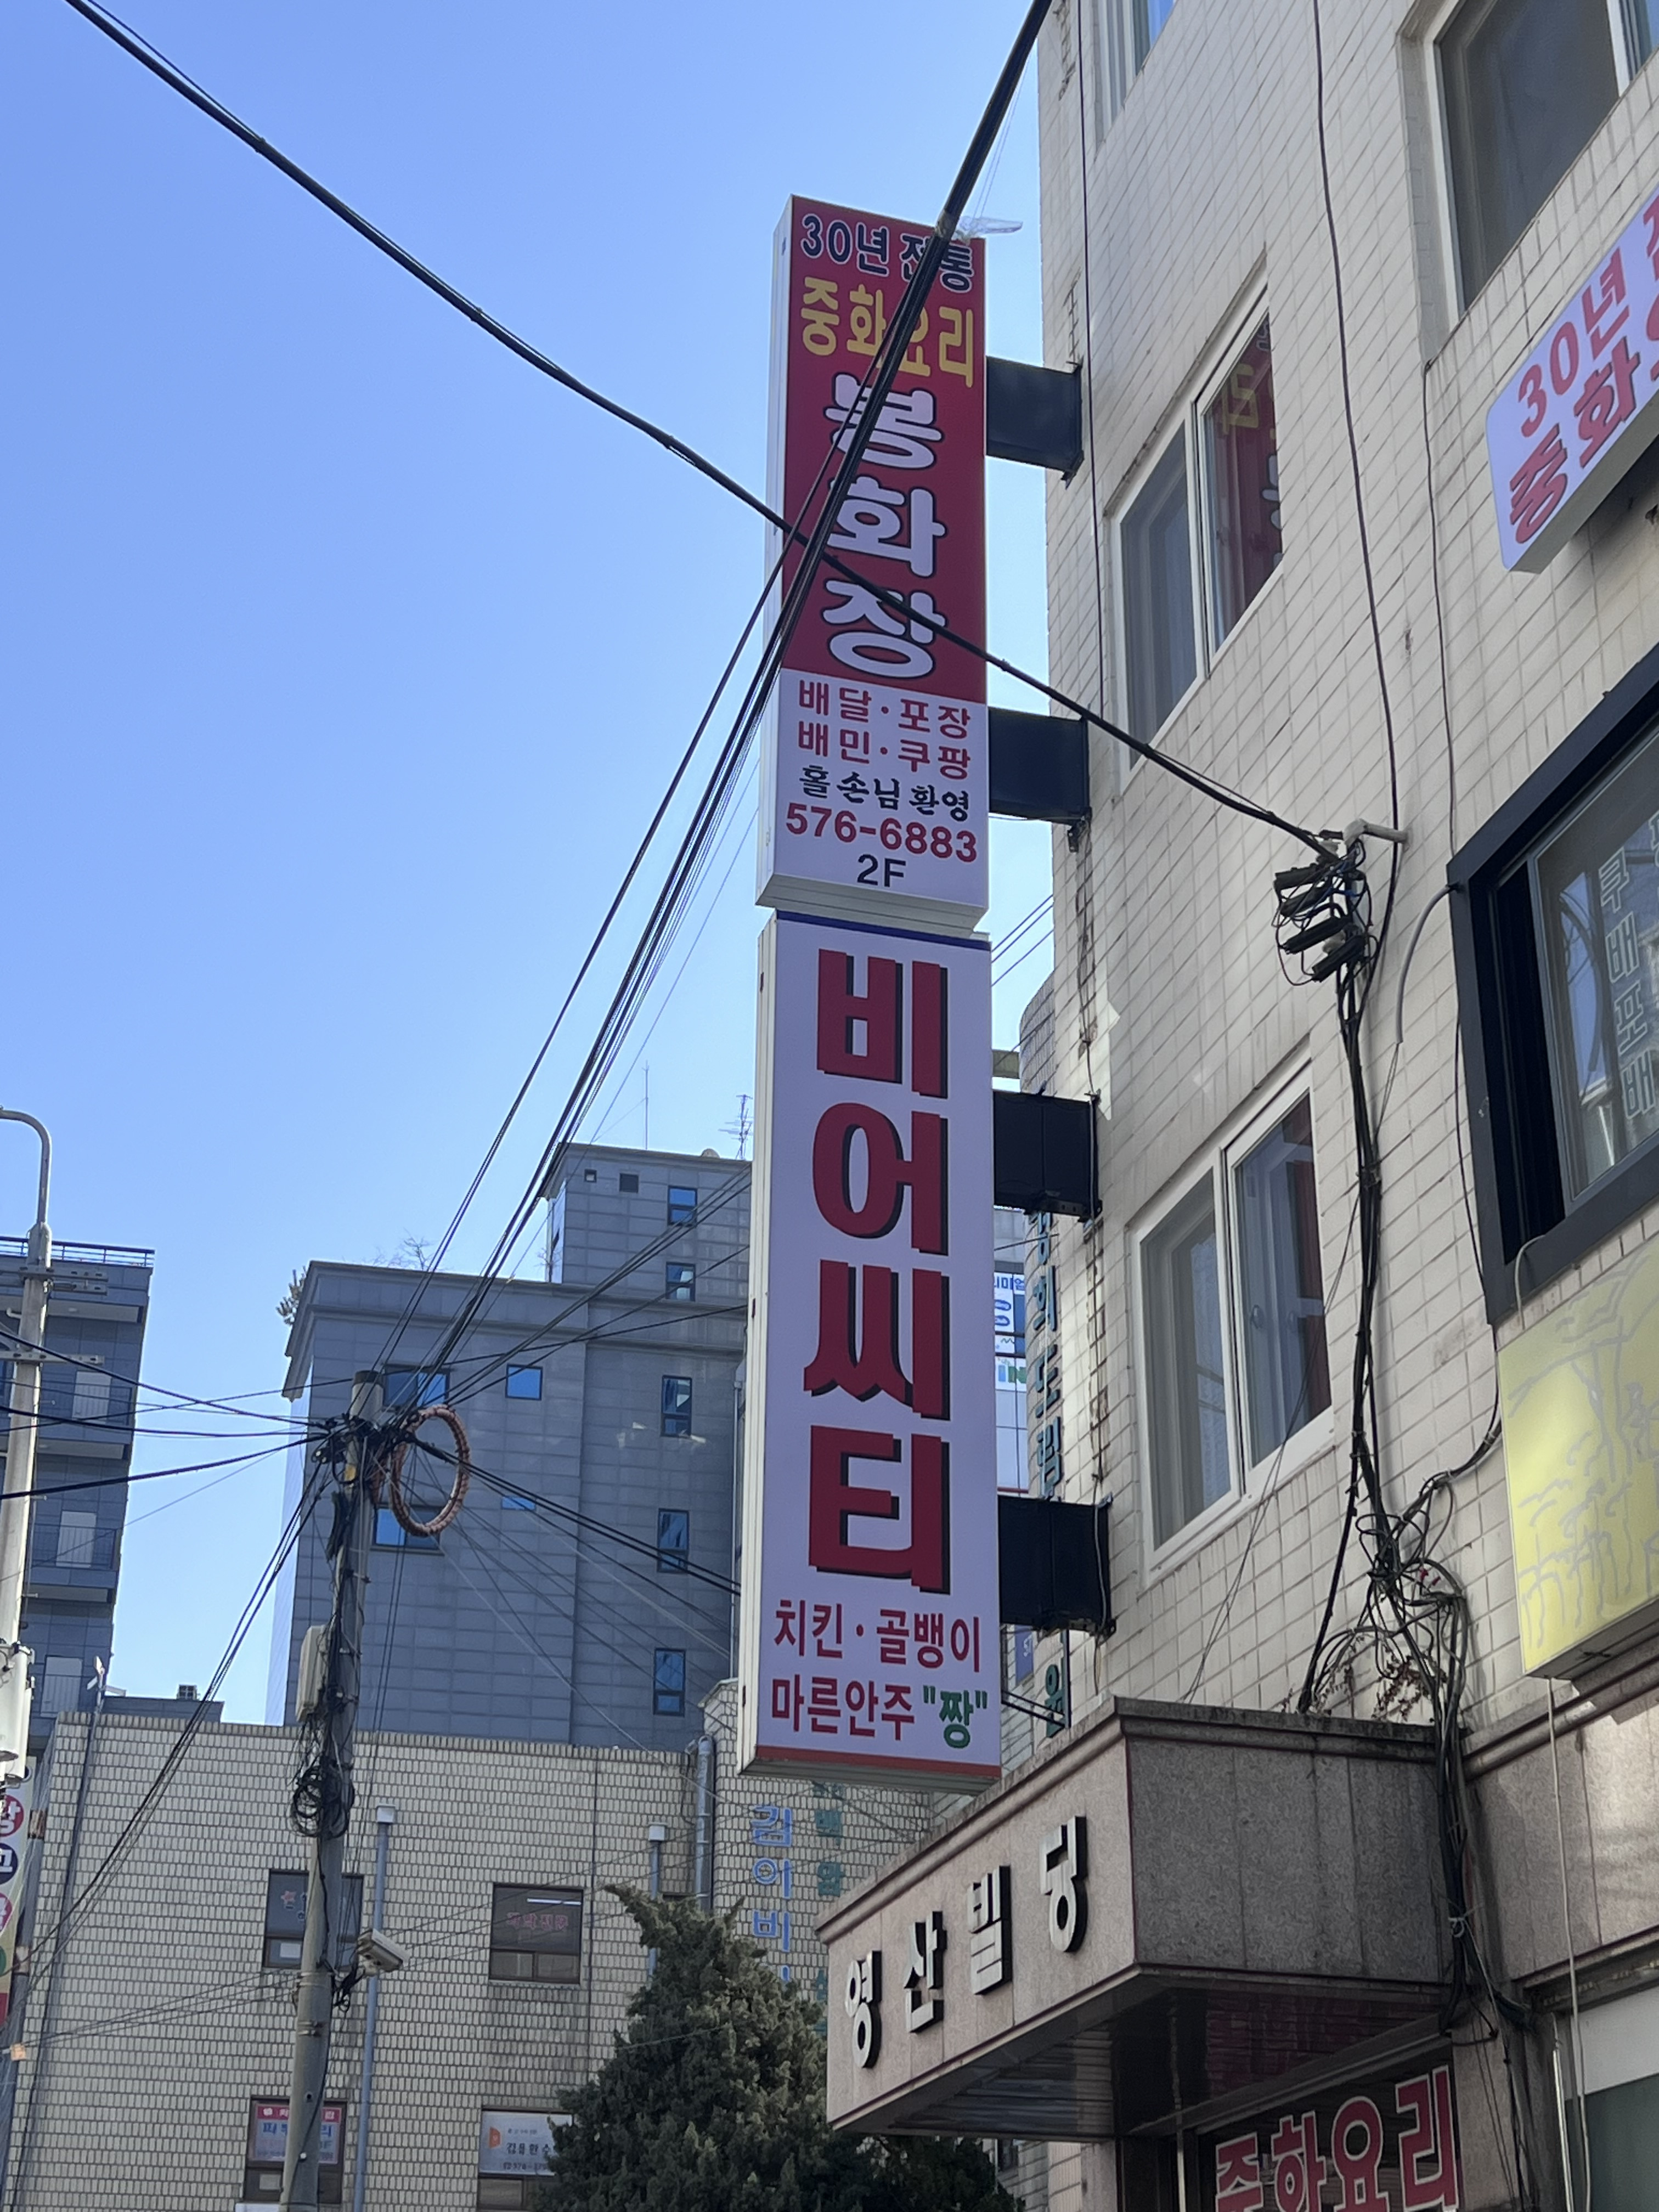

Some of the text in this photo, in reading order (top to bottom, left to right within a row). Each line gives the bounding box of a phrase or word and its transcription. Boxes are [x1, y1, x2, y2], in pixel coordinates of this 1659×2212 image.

[801, 213, 890, 278] 30년
[1517, 246, 1630, 438] 30년
[822, 370, 947, 679] 봉화장
[786, 802, 978, 863] 576-6883
[857, 854, 906, 888] 2F
[803, 948, 951, 1595] 비어씨티
[750, 1804, 792, 1983] 길이비
[845, 1815, 1088, 2069] 영산빌딩
